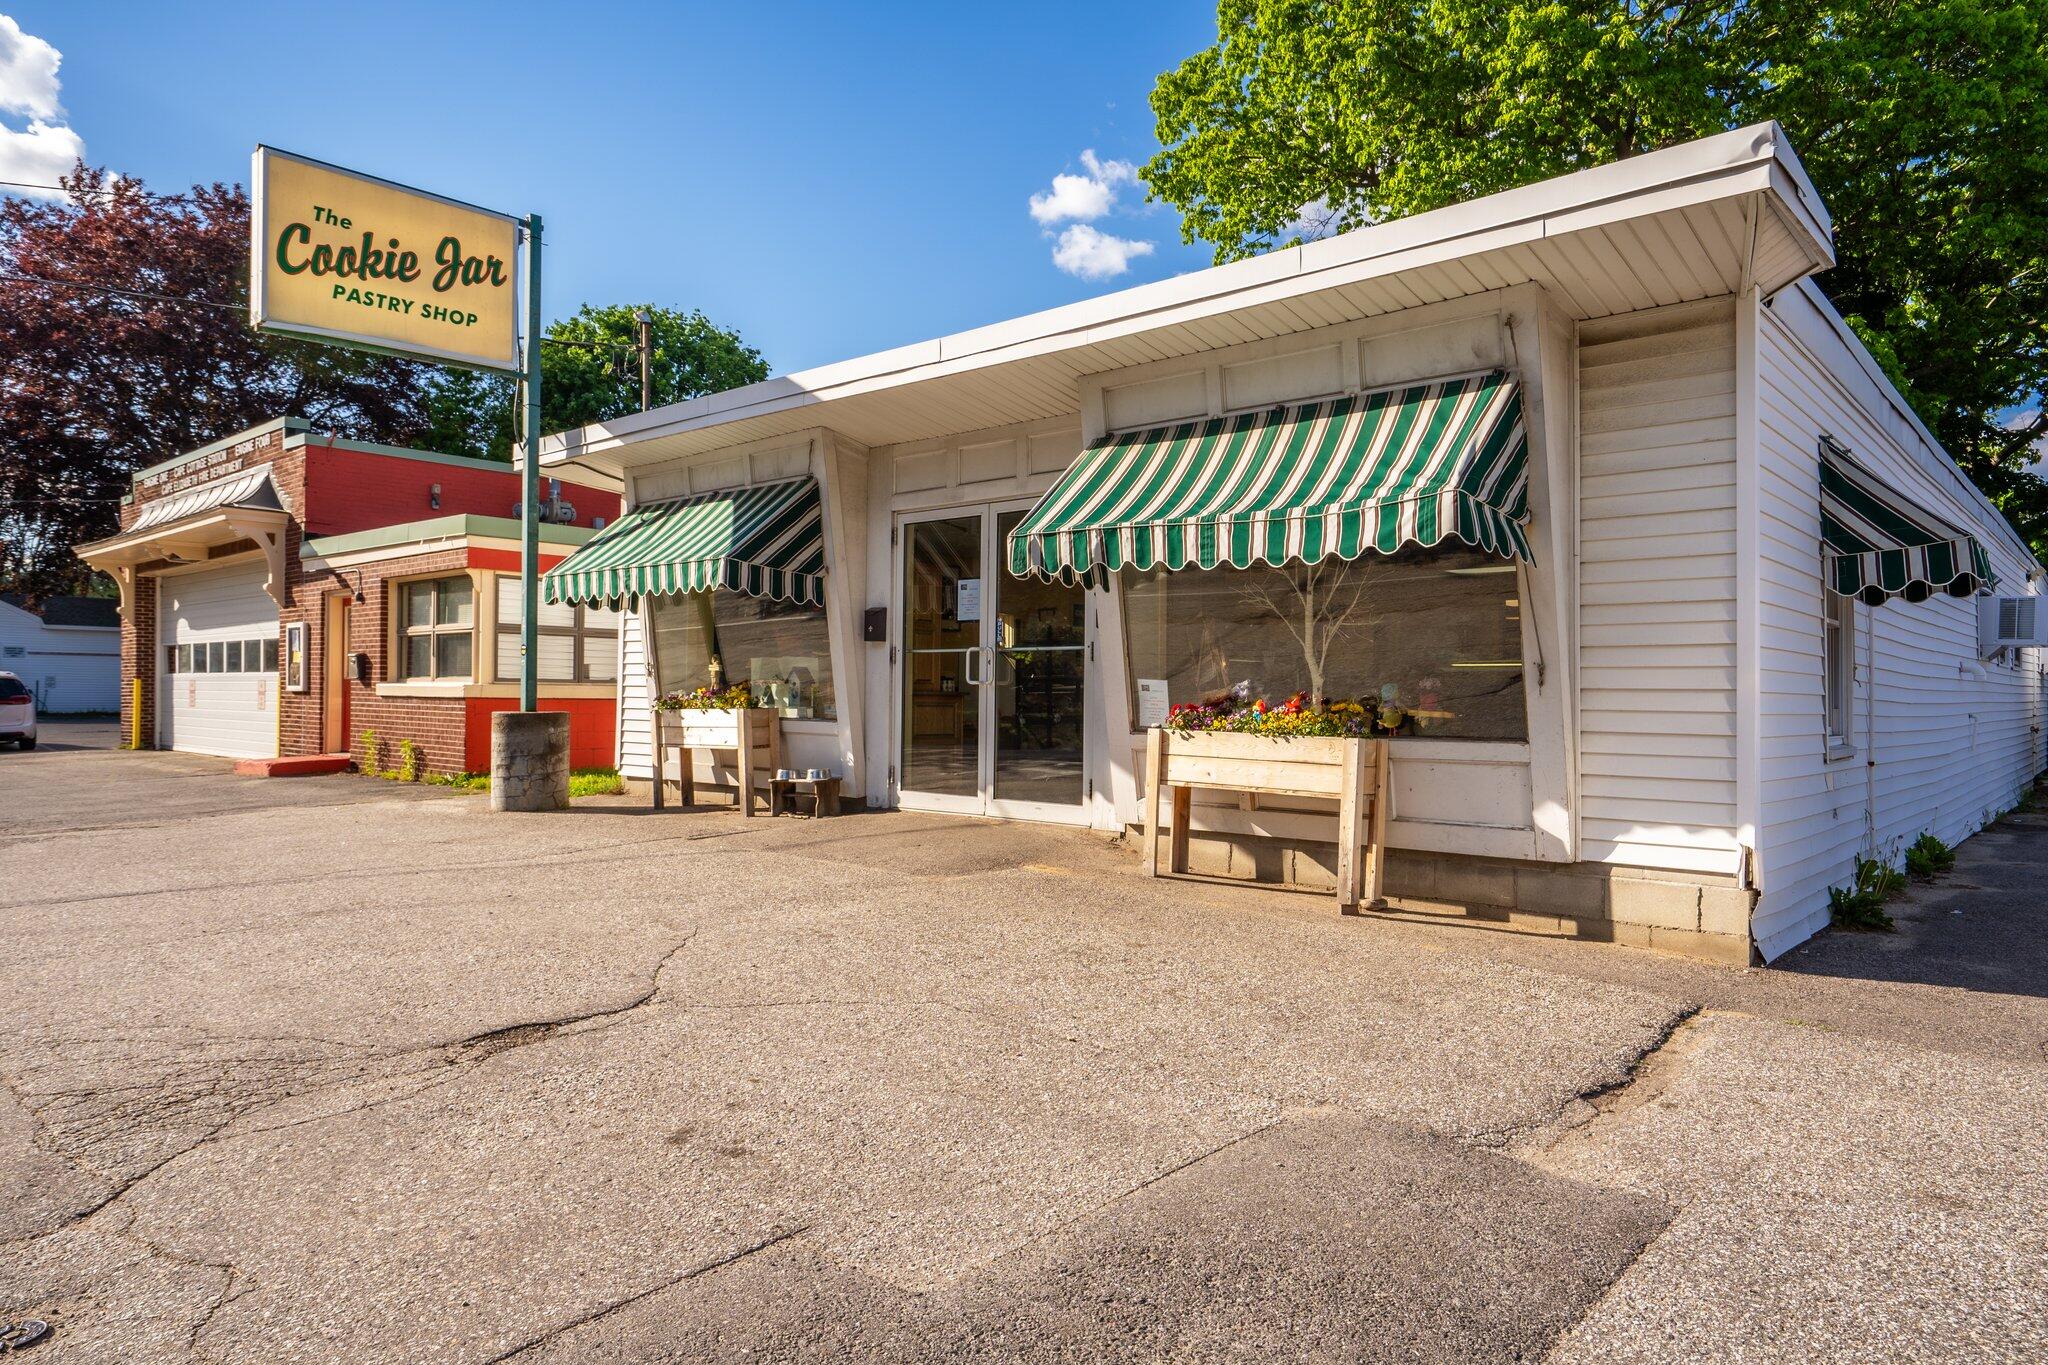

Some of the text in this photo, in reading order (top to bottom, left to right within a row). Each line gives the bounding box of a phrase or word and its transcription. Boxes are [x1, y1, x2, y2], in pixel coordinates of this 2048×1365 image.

[313, 205, 352, 230] The
[276, 222, 507, 293] Cookie Jar
[332, 284, 479, 328] PASTRY SHOP
[234, 439, 255, 457] ENGINE
